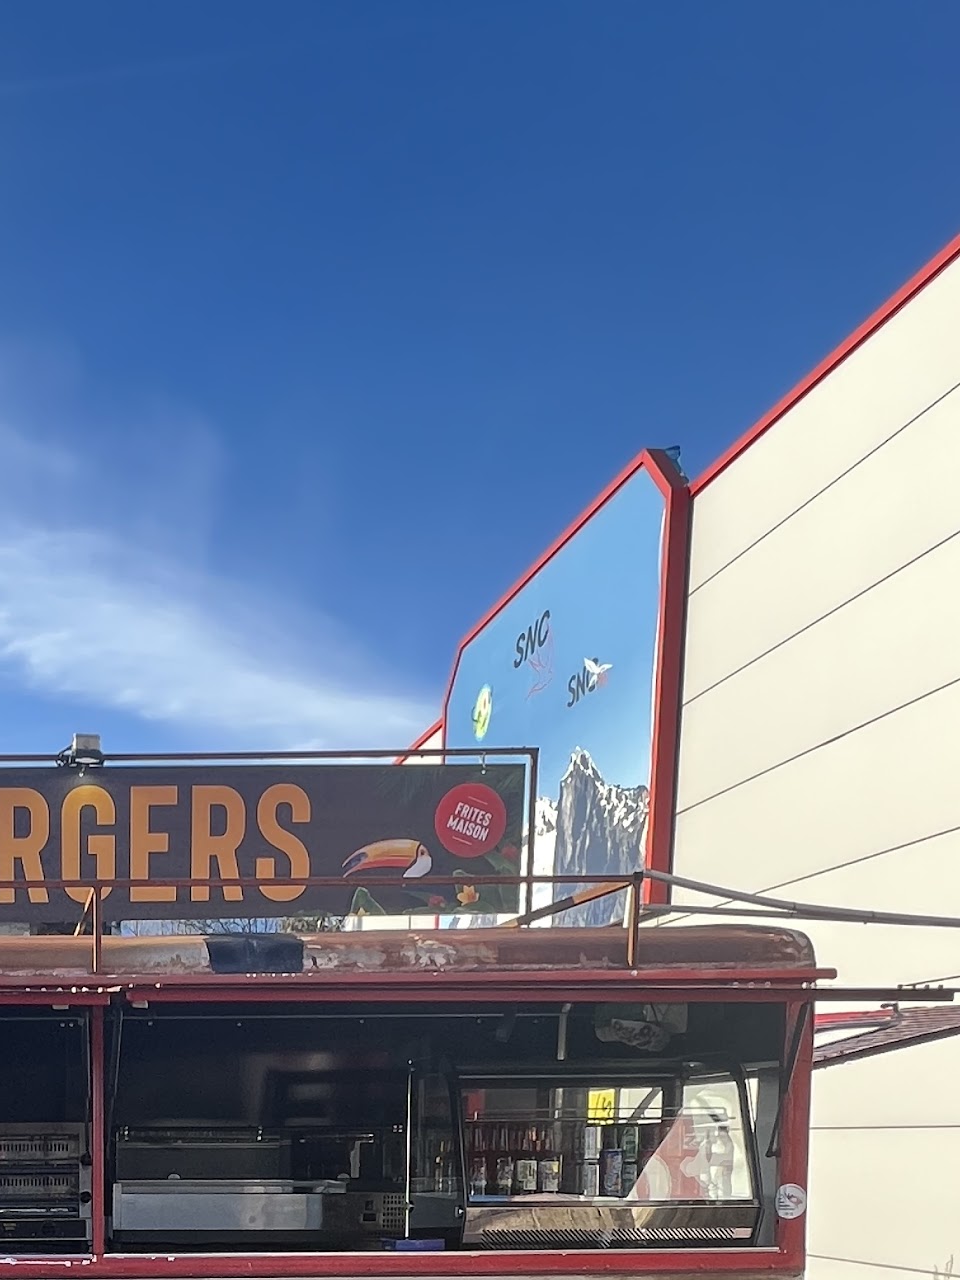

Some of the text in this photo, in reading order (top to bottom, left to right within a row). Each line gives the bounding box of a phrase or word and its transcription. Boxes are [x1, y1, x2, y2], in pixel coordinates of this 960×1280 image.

[513, 609, 551, 669] SNC
[446, 814, 490, 842] MAISON
[454, 801, 493, 827] FRITES
